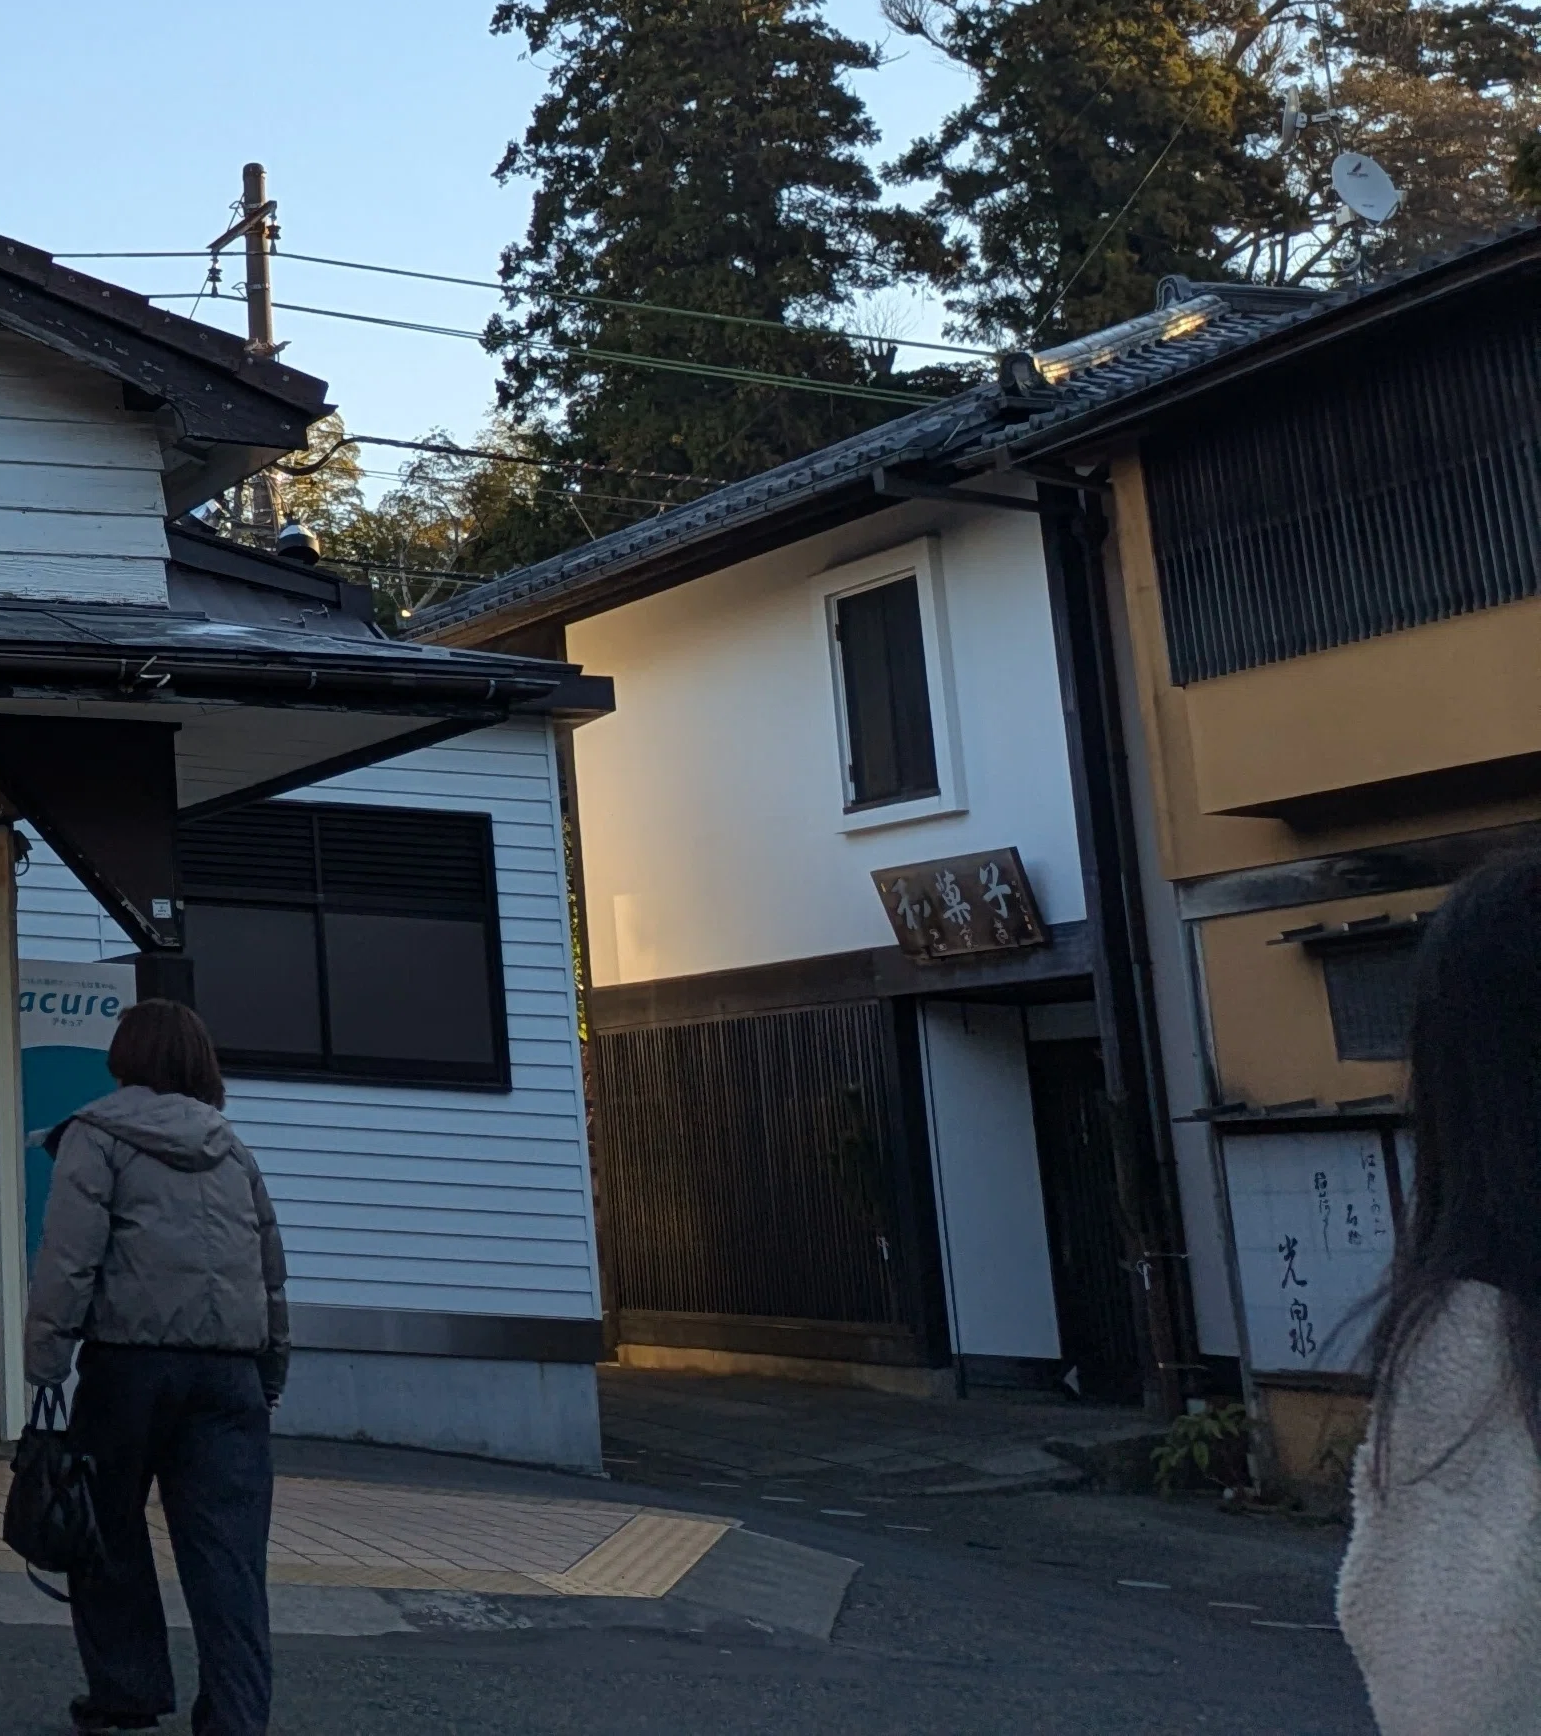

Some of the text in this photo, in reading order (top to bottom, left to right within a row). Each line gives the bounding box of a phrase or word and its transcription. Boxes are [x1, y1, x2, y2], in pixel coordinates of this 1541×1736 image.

[891, 862, 1012, 931] 和菓子
[19, 991, 120, 1018] acure
